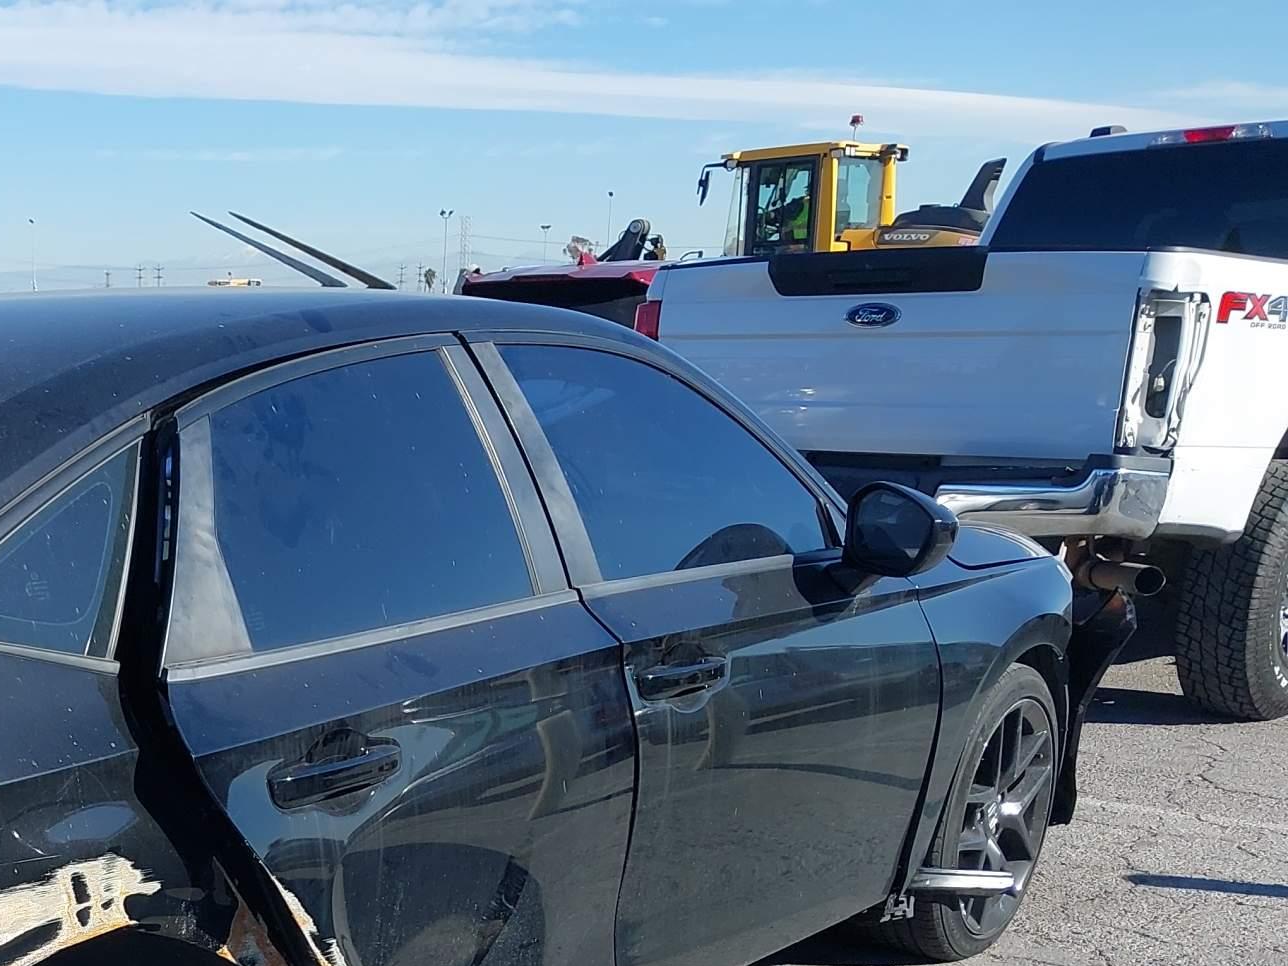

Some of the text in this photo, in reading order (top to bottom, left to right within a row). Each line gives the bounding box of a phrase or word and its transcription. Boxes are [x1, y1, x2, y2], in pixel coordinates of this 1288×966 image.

[883, 233, 930, 241] VOLVO
[855, 307, 887, 323] Ford
[1216, 291, 1288, 324] FX4
